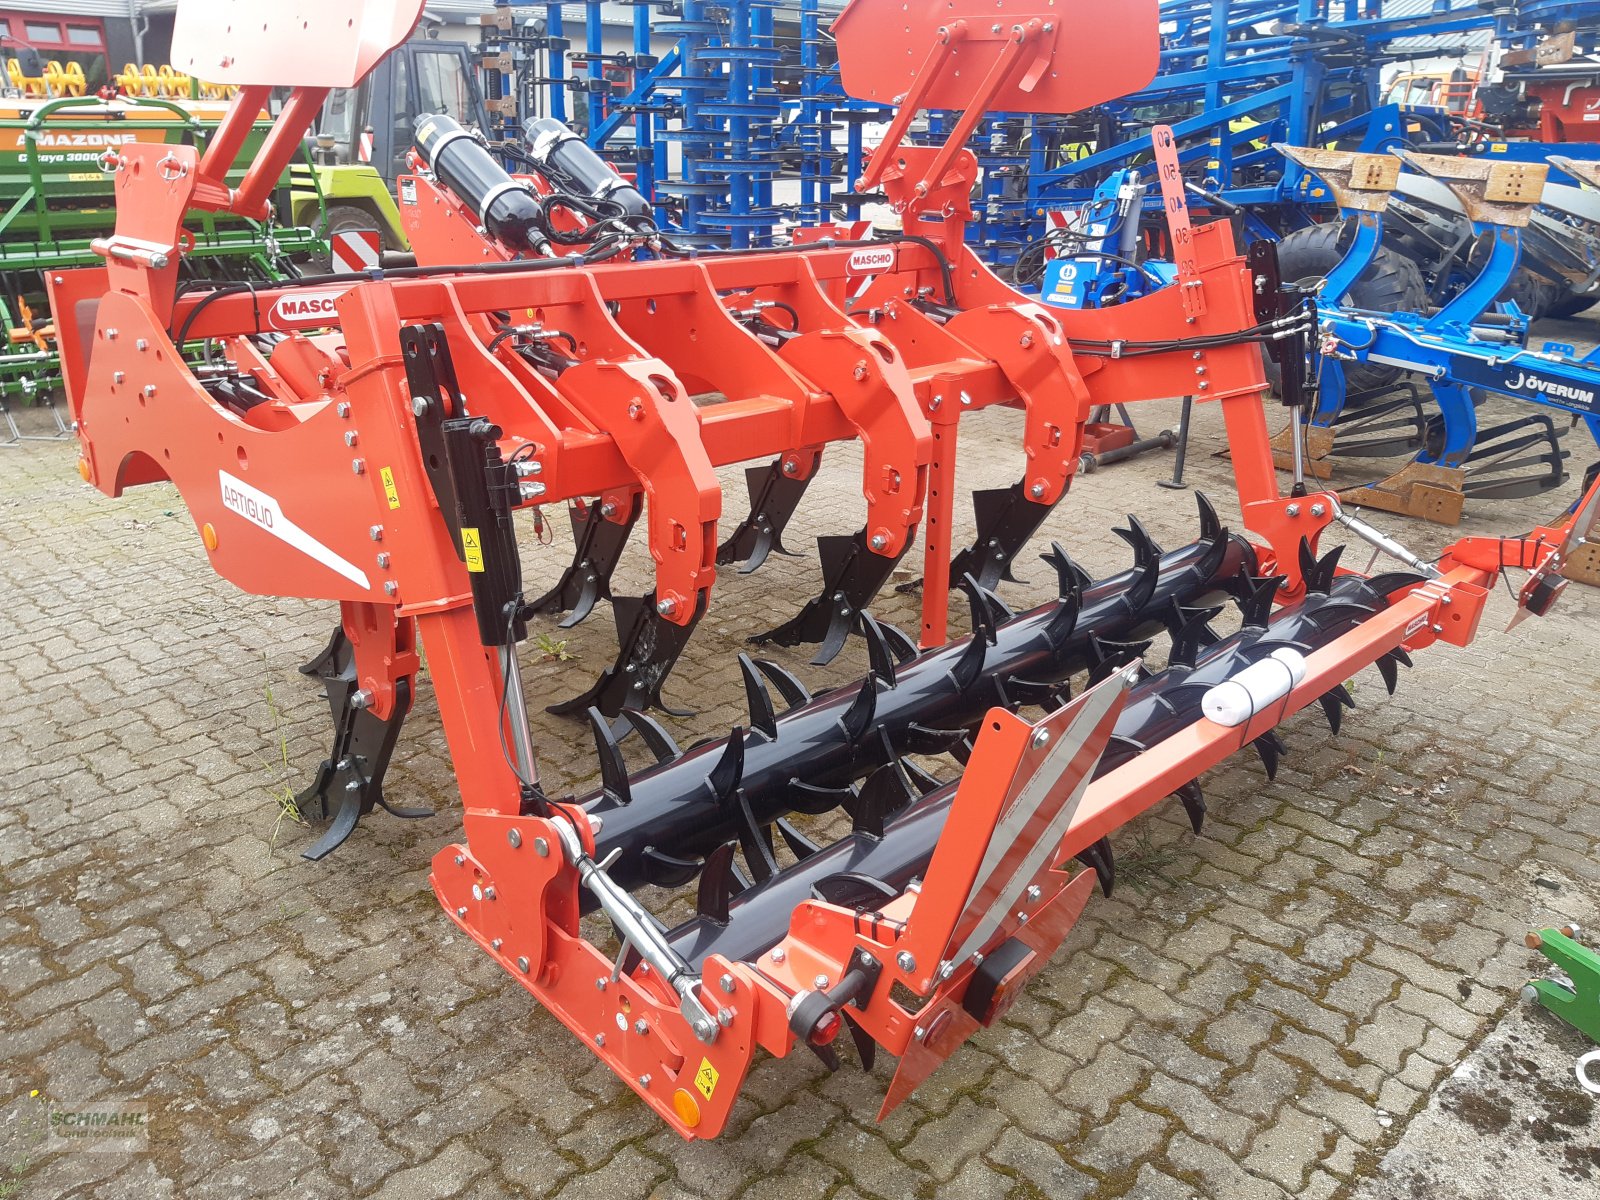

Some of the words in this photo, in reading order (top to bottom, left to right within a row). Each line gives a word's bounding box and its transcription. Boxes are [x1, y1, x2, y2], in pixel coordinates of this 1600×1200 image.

[66, 153, 98, 162] 3000
[852, 253, 892, 266] MASCHIO
[1525, 375, 1595, 403] ÖVERUM
[224, 485, 274, 529] ARTIGLIO
